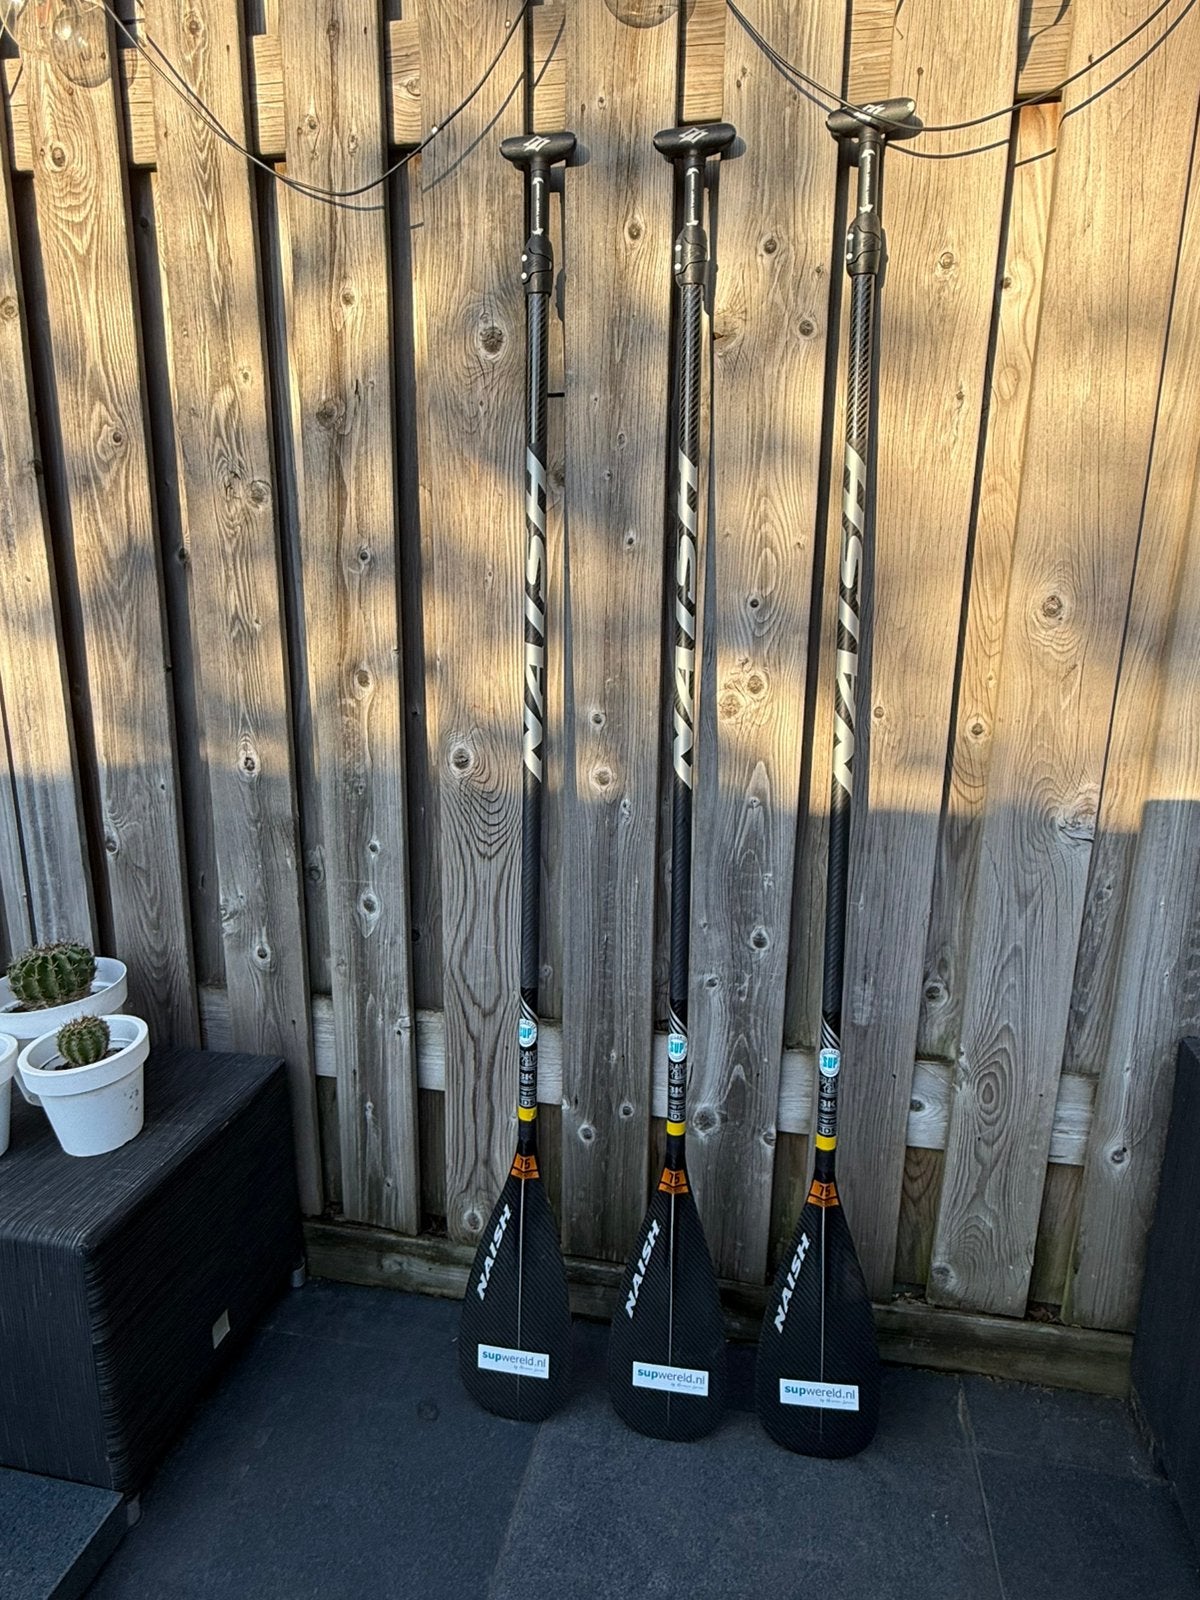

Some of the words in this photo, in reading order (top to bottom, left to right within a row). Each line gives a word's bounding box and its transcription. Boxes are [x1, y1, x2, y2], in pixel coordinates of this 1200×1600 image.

[670, 1041, 685, 1054] SUP
[823, 1055, 838, 1068] SUP
[520, 1158, 531, 1169] 75
[669, 1172, 680, 1183] 75
[819, 1185, 831, 1196] 75
[477, 1203, 512, 1300] NAISH
[625, 1219, 661, 1319] NAISH
[774, 1232, 812, 1334] NAISH
[482, 1350, 547, 1368] supwereld.nl
[637, 1368, 705, 1385] supwereld.nl
[784, 1385, 856, 1400] supwereld.nl
